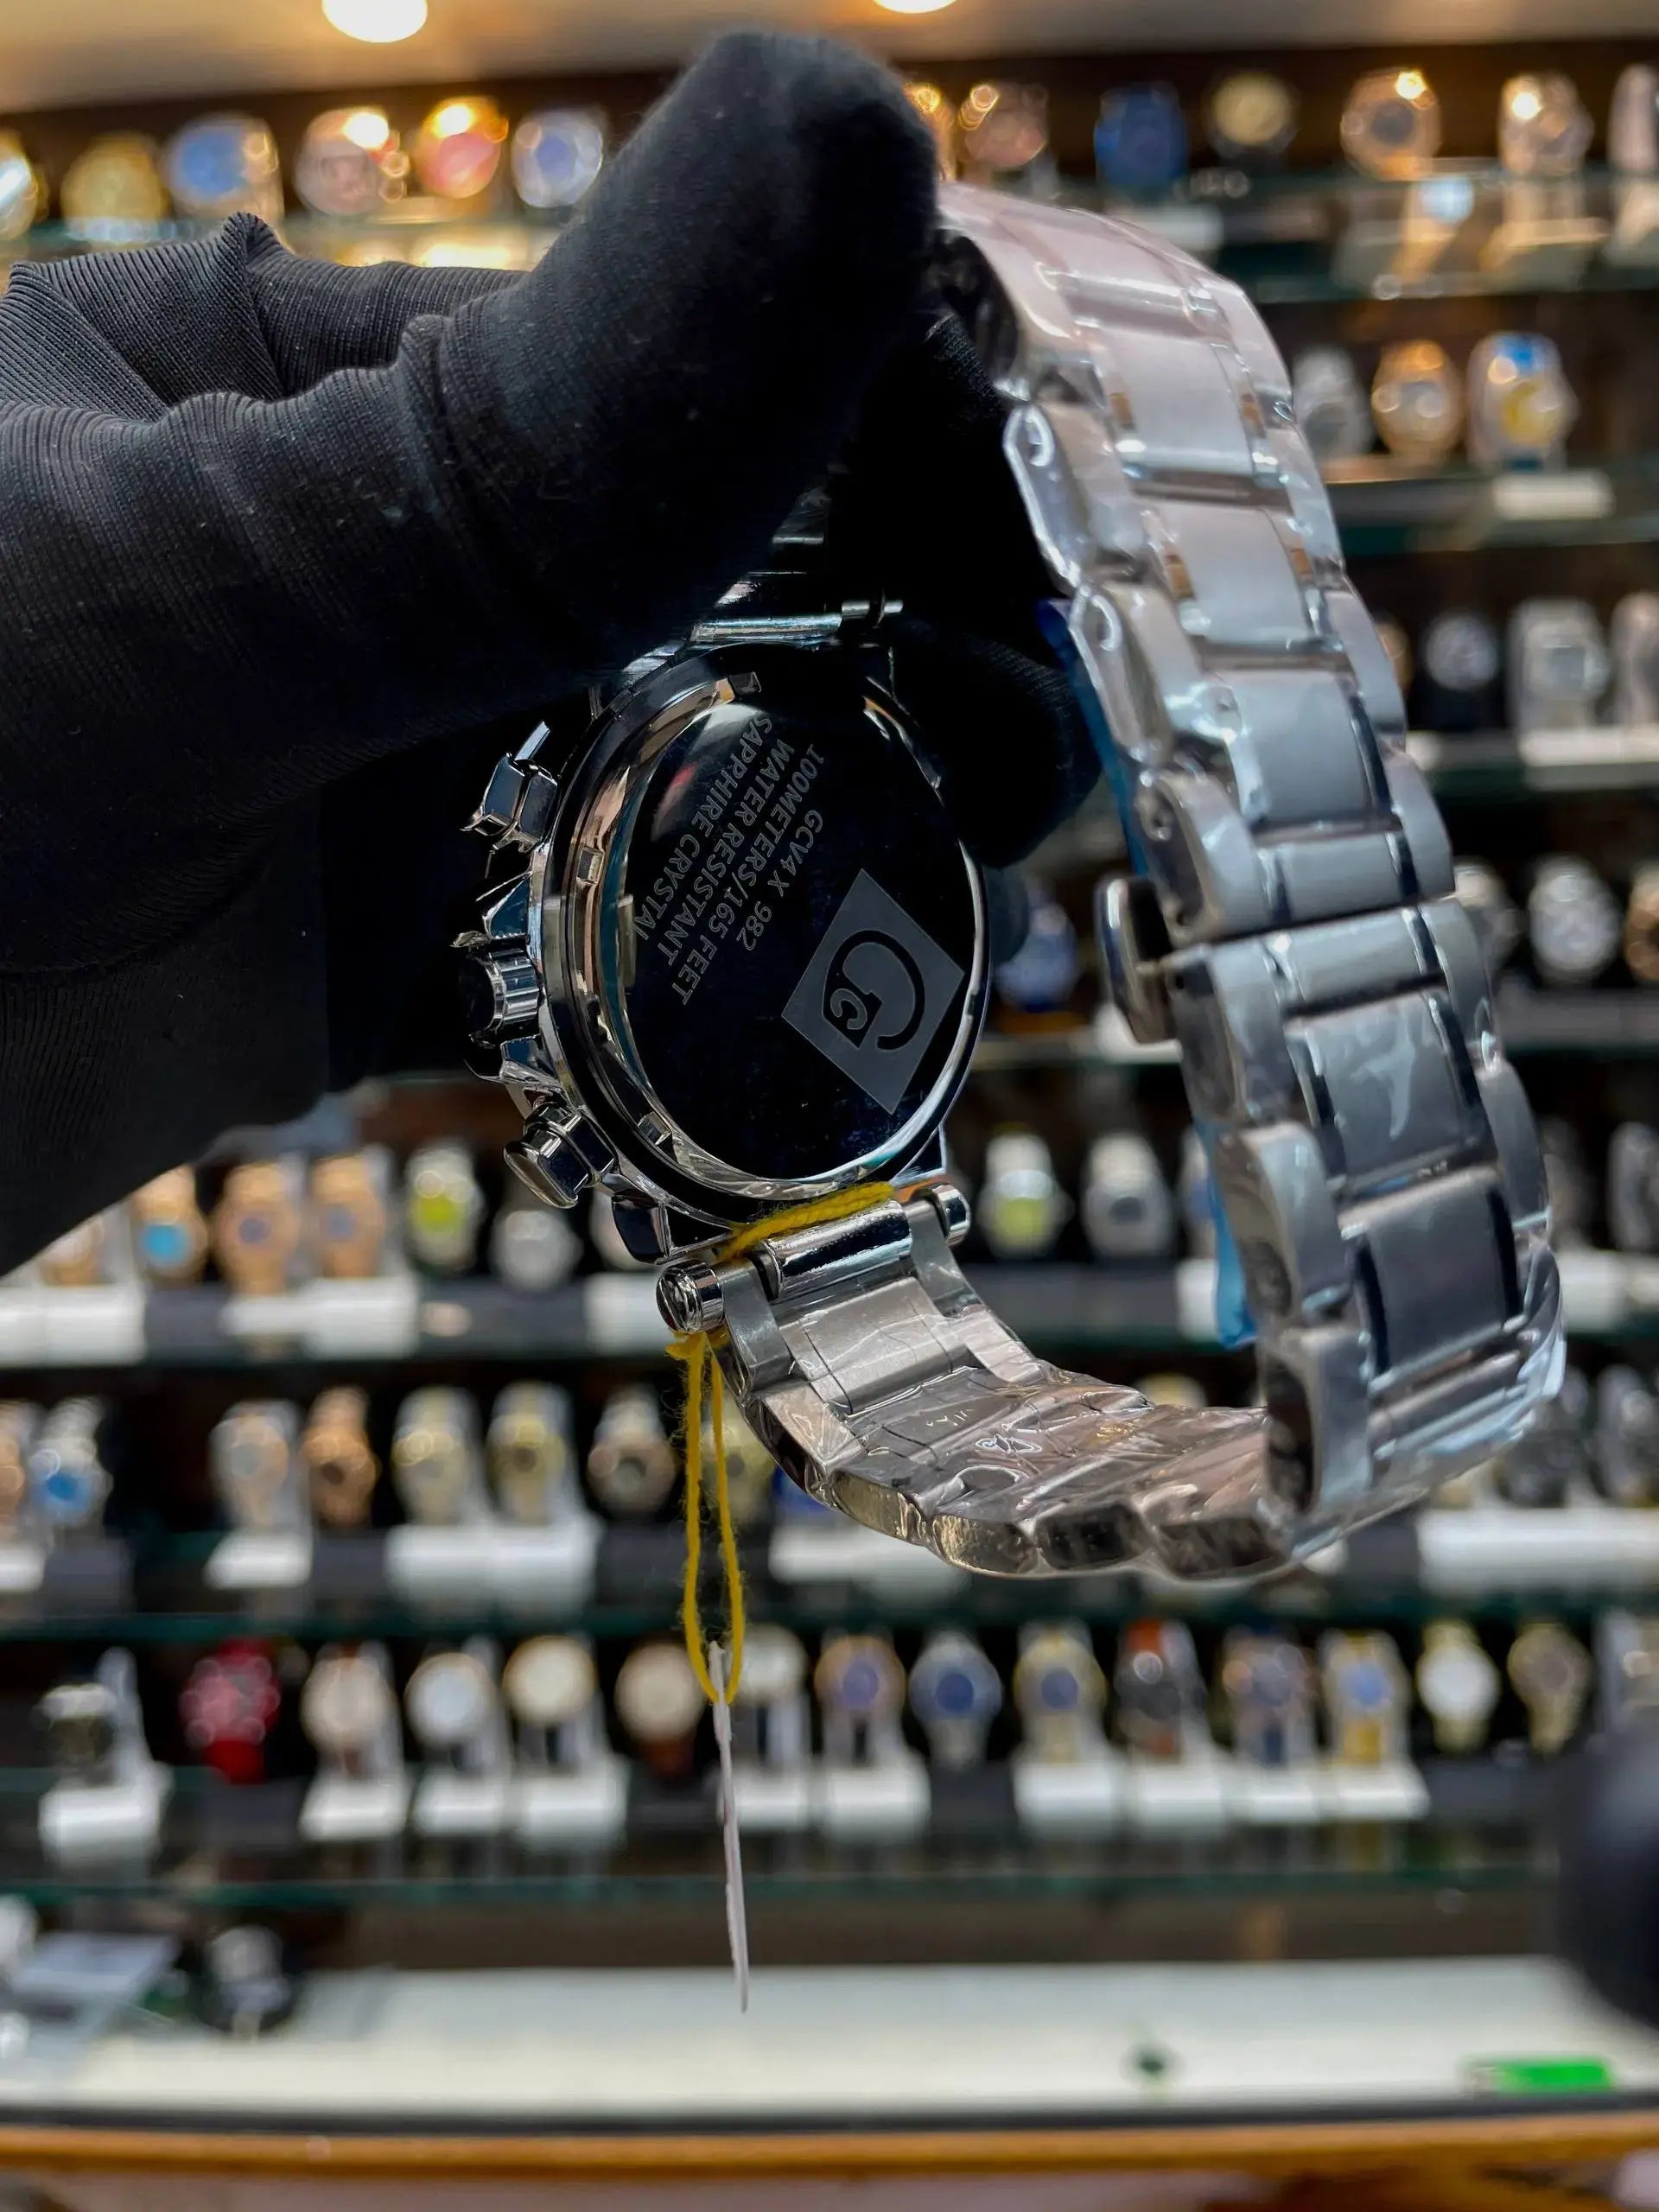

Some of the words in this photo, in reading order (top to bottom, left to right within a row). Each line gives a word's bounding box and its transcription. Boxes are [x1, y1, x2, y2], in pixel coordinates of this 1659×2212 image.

[692, 718, 772, 837] SAPPHIRE
[734, 739, 795, 826] WATER
[709, 744, 824, 938] 100METERS/165
[657, 823, 745, 966] RESISTANT
[736, 900, 772, 950] 982
[672, 935, 717, 1005] FEET
